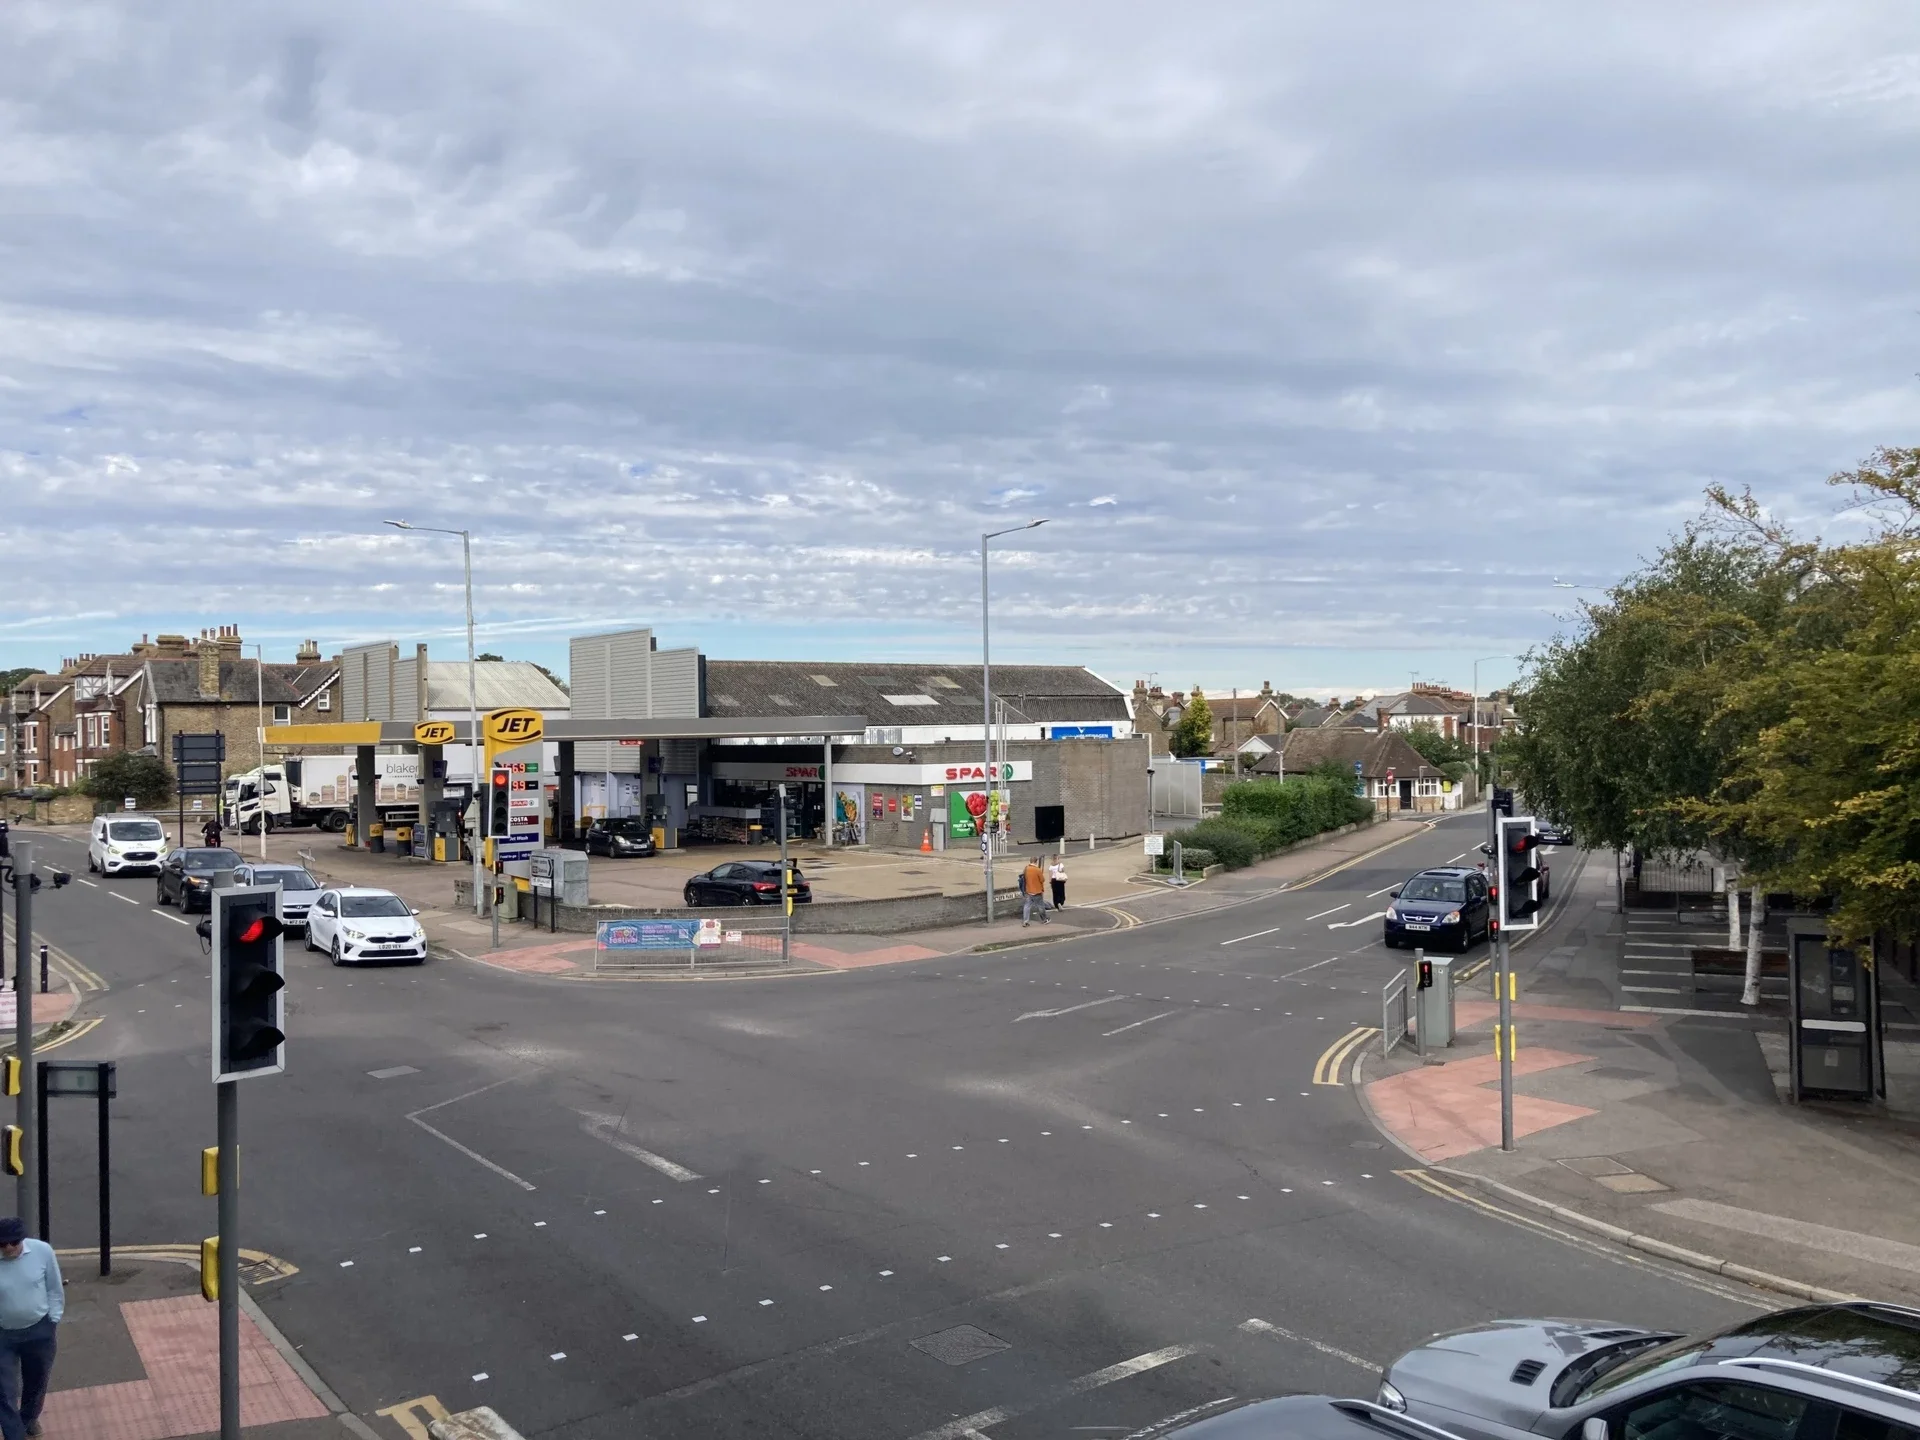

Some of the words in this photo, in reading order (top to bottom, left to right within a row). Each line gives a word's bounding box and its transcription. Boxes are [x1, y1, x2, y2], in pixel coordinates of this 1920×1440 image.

[497, 718, 536, 733] JET
[421, 727, 449, 739] JET
[785, 766, 818, 778] SPAR
[945, 766, 997, 780] SPAR
